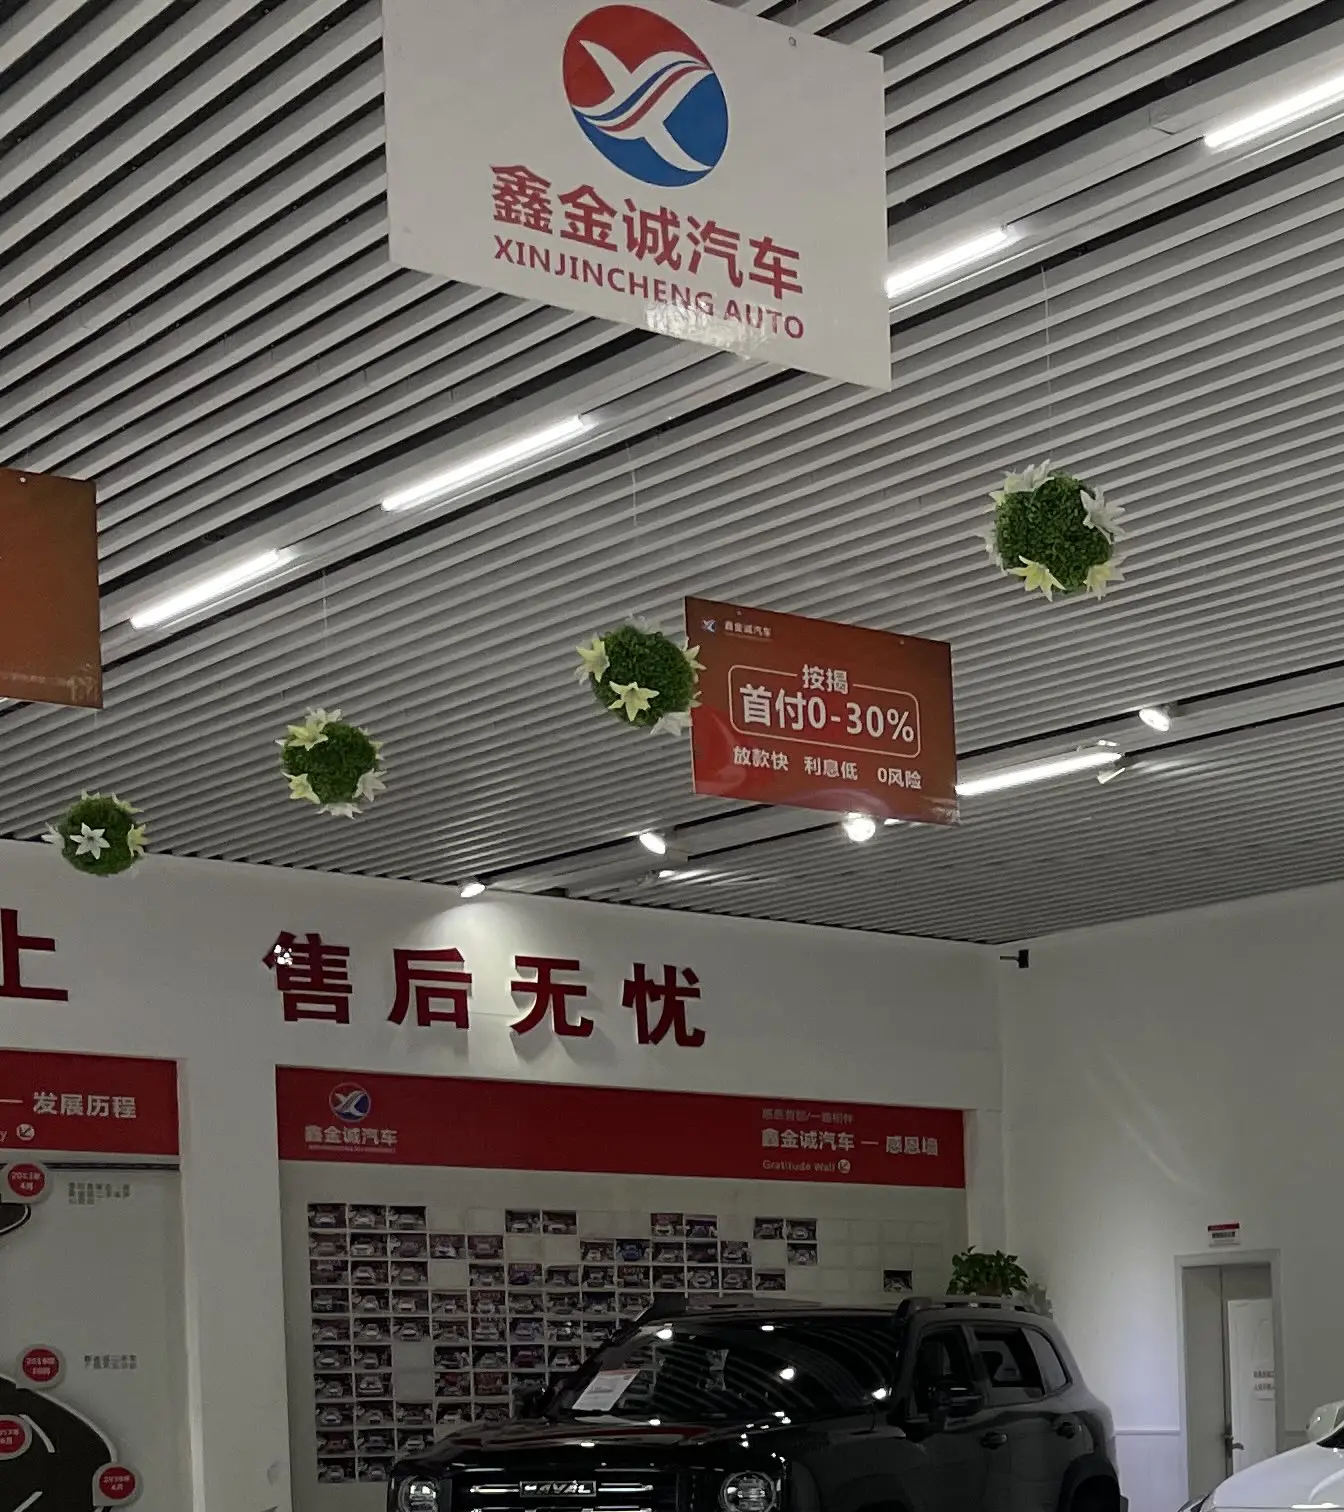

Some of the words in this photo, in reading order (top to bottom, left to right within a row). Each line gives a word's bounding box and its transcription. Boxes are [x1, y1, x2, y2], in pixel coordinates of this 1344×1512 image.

[490, 164, 803, 299] 鑫金诚汽车
[493, 235, 715, 316] XINJINCHENG
[723, 301, 805, 338] AUTO
[802, 664, 849, 694] 按揭
[739, 684, 915, 742] 首付0-30%
[733, 746, 789, 771] 放款快
[803, 756, 858, 780] 利息低
[877, 767, 922, 790] 0风险
[262, 931, 706, 1047] 售后无忧
[33, 1091, 137, 1119] 发展历程
